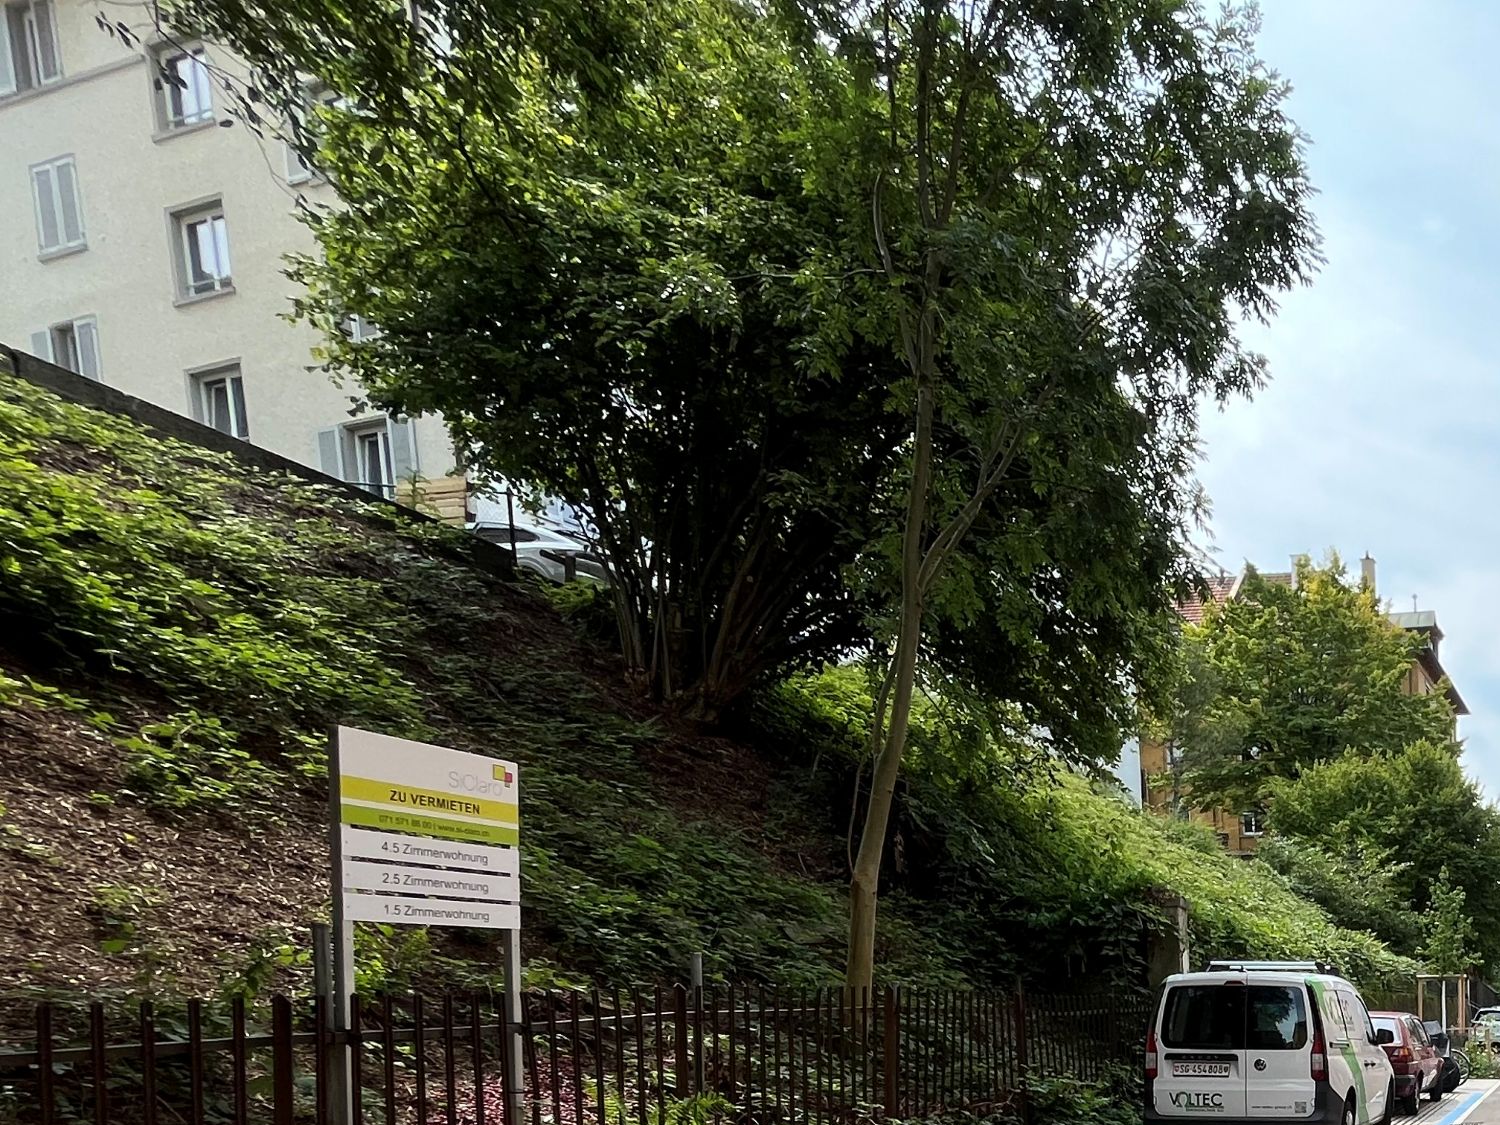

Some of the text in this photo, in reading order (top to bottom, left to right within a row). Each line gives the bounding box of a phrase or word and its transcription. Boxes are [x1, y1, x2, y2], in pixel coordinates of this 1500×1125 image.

[390, 789, 480, 814] ZU VERMIETEN
[382, 842, 489, 866] 4.5 Zimmerwohnung
[382, 873, 489, 895] 2.5 Zimmerwohnung
[384, 904, 490, 923] 1.5 Zimmerwohnung
[1169, 1091, 1223, 1108] VOLTEC
